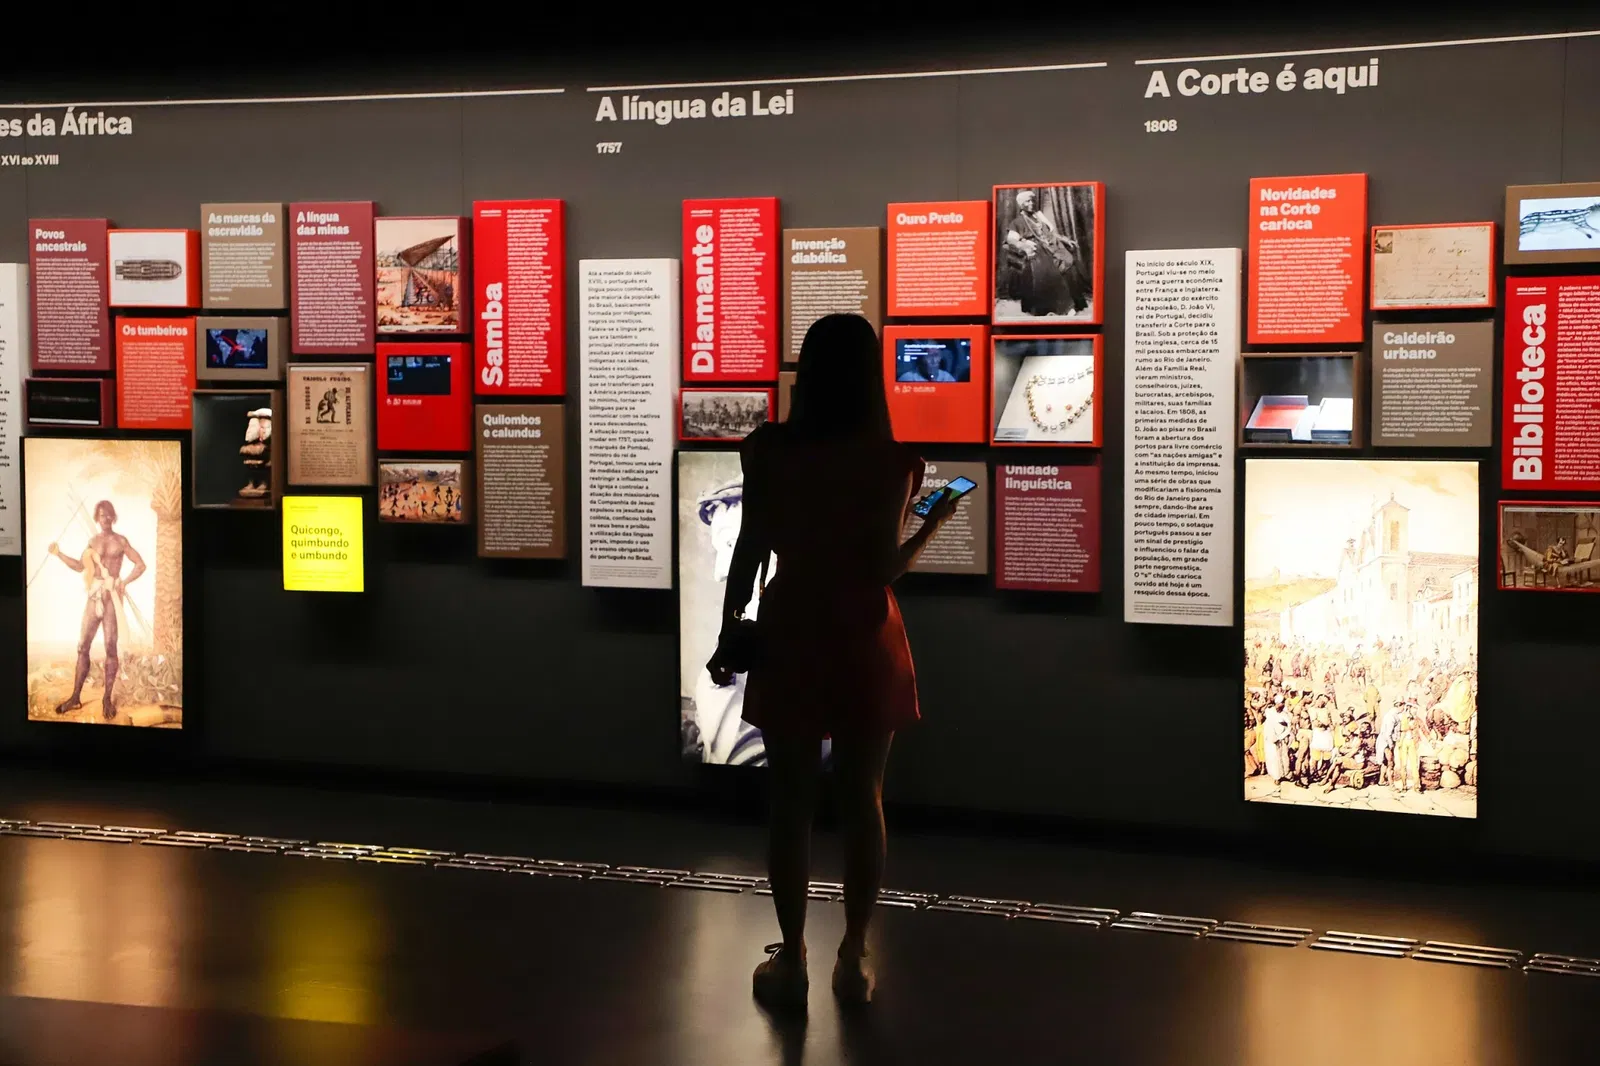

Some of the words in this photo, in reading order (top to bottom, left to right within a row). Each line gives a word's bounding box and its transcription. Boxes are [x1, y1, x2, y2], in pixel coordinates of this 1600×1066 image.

[1144, 70, 1170, 98] A
[1176, 68, 1270, 96] Corte
[1276, 63, 1296, 92] é
[1303, 58, 1379, 94] aqui
[596, 96, 618, 121] A
[622, 96, 706, 125] língua
[712, 92, 746, 117] da
[752, 89, 794, 116] Lei
[26, 113, 56, 136] da
[60, 106, 132, 136] África
[1144, 120, 1177, 132] 1808
[596, 142, 622, 153] 1757
[2, 155, 20, 165] XVI
[35, 155, 58, 165] XVIII
[1261, 187, 1336, 201] Novidades
[1260, 206, 1278, 216] na
[1280, 203, 1320, 215] Corte
[208, 213, 222, 223] As
[223, 215, 261, 223] marcas
[262, 212, 275, 223] da
[297, 212, 305, 223] A
[307, 211, 339, 226] língua
[896, 213, 928, 225] Ouro
[928, 212, 963, 224] Preto
[208, 225, 263, 236] escravidão
[297, 224, 316, 235] das
[318, 224, 349, 235] minas
[1260, 218, 1312, 231] carioca
[36, 229, 64, 239] Povos
[36, 241, 87, 252] ancestrais
[792, 238, 846, 253] Invenção
[792, 252, 846, 264] diabólica
[692, 225, 714, 372] Diamante
[123, 325, 136, 335] Os
[137, 326, 188, 336] tumbeiros
[482, 282, 503, 386] Samba
[1384, 332, 1455, 344] Caldeirão
[1384, 347, 1436, 359] urbano
[1513, 304, 1546, 480] Biblioteca
[483, 414, 541, 426] Quilombos
[484, 429, 490, 438] e
[492, 427, 541, 438] calundus
[1005, 466, 1059, 477] Unidade
[1005, 477, 1072, 491] linguística
[291, 525, 342, 536] Quicongo,
[291, 538, 349, 550] quimbundo
[300, 551, 347, 560] umbundo
